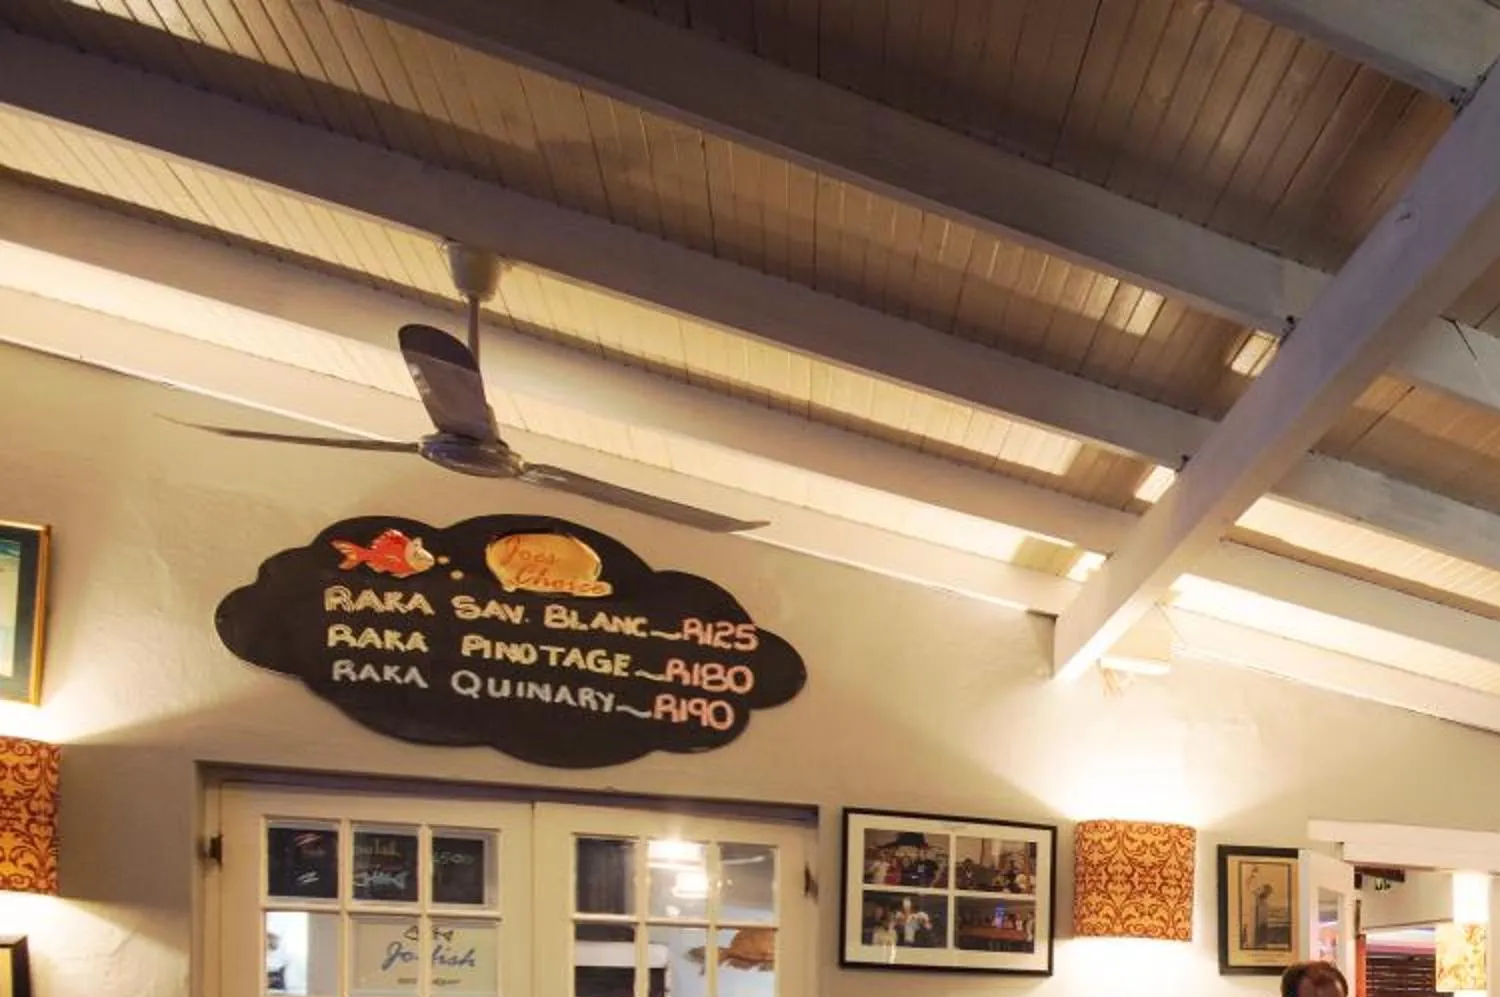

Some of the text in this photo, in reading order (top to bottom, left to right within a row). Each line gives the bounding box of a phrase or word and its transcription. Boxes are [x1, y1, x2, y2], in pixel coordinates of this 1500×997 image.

[324, 585, 759, 651] RAKA SAV. BLANC R125
[326, 623, 754, 694] RAKA PINOTAGE R180
[331, 659, 735, 730] RAKA QUINARY R190
